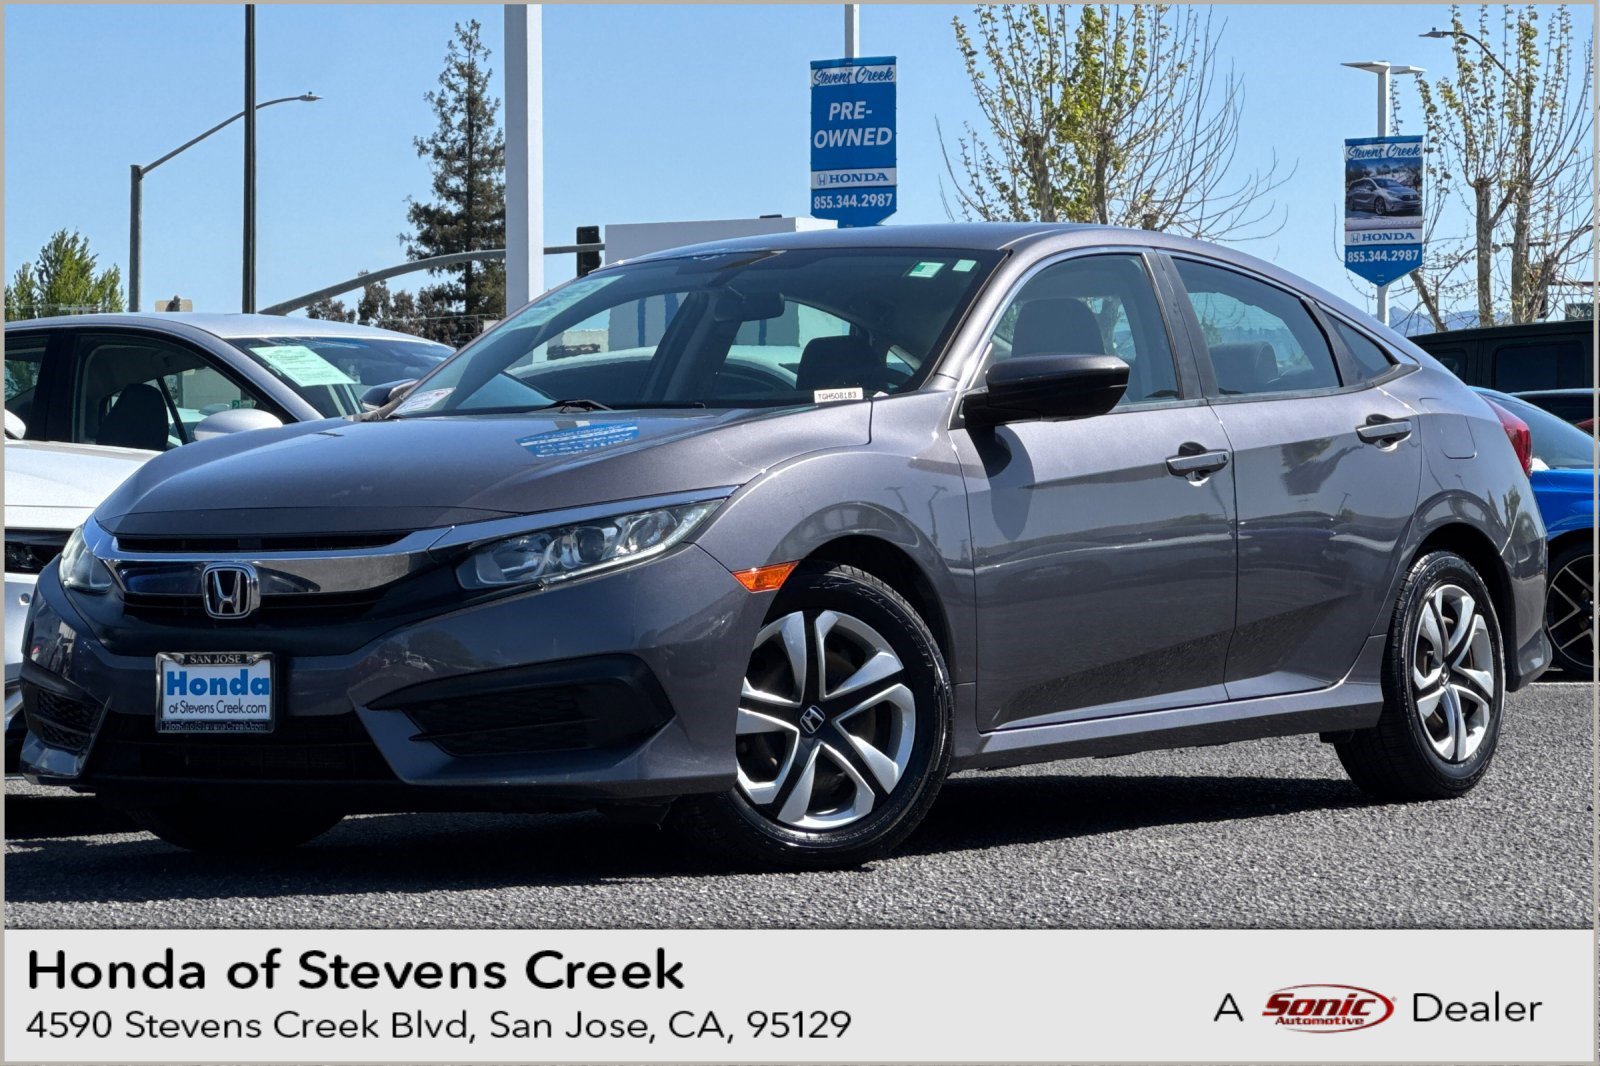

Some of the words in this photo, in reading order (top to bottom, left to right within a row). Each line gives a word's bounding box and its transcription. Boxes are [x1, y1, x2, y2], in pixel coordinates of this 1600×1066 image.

[813, 69, 852, 86] Stevens
[855, 66, 894, 84] Creek
[828, 101, 872, 121] PRE-
[813, 127, 893, 149] OWNED
[1347, 145, 1384, 160] Stevens
[1386, 143, 1421, 158] Creek
[828, 172, 889, 184] HONDA
[813, 193, 893, 210] 855.344.2987
[1361, 232, 1415, 242] HONDA
[1347, 249, 1419, 263] 855.344.2987
[190, 655, 212, 664] SAN
[214, 654, 242, 664] JOSE
[167, 668, 270, 696] Honda
[168, 700, 179, 714] of
[179, 699, 215, 714] Stevens
